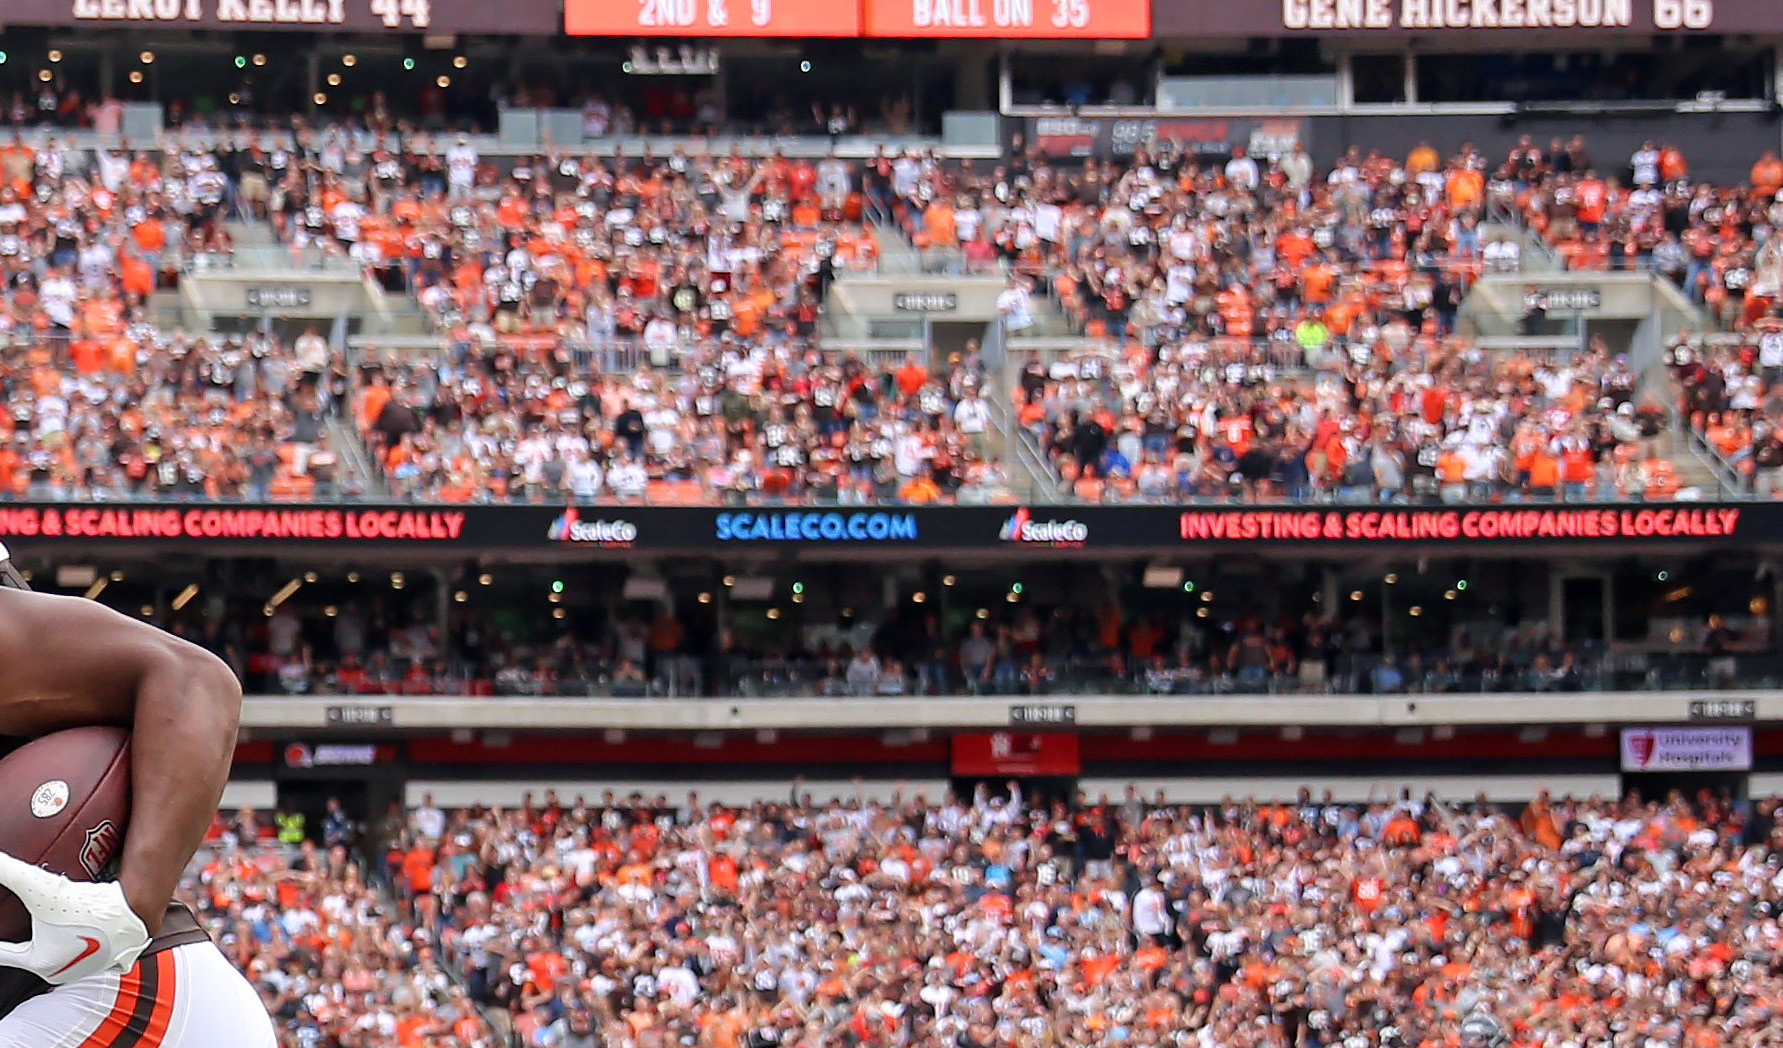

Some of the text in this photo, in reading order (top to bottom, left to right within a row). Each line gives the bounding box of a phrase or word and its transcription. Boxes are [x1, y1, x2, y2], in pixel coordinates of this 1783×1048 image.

[637, 0, 771, 27] 2ND & 9
[912, 0, 1090, 28] BALL ON 35
[1284, 0, 1713, 29] GENE HICKERSON 66
[41, 510, 62, 537] &
[66, 508, 182, 537] SCALING
[185, 509, 343, 539] COMPANIES
[345, 511, 465, 540] LOCALLY
[715, 512, 918, 541] SCALECO.COM
[1179, 508, 1741, 539] INVESTING & SCALING COMPANIES LOCALLY
